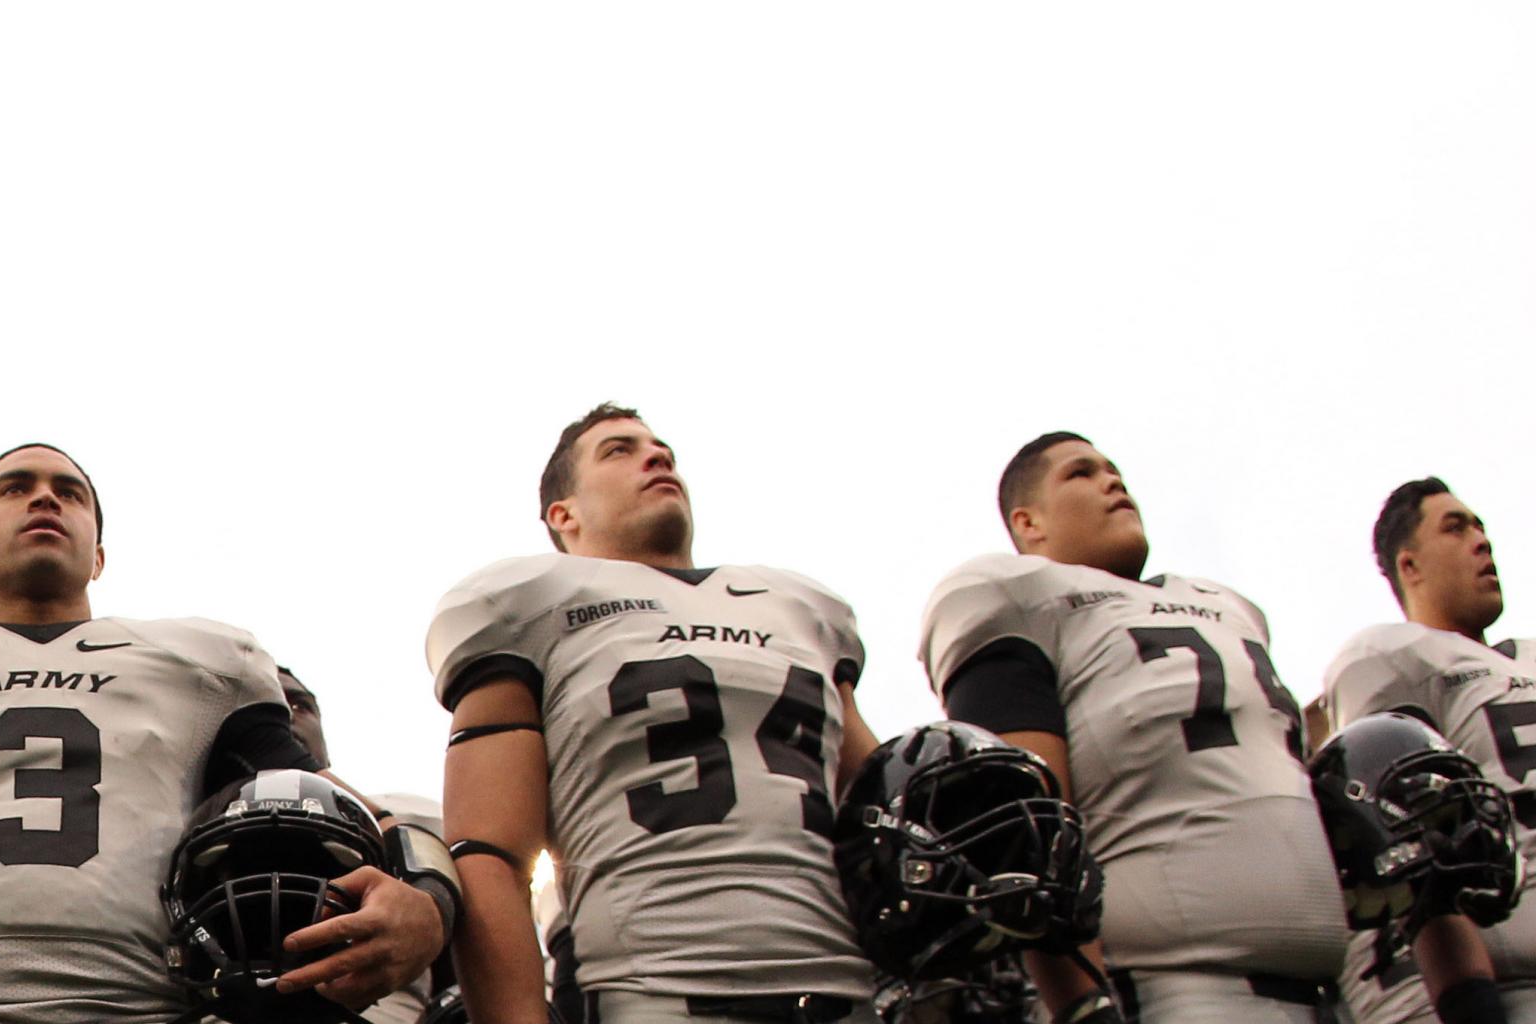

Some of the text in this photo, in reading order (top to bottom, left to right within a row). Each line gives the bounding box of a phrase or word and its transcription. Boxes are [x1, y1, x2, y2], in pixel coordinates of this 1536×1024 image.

[566, 599, 657, 627] FORGRAVE
[657, 624, 773, 647] ARMY
[607, 653, 837, 840] 34
